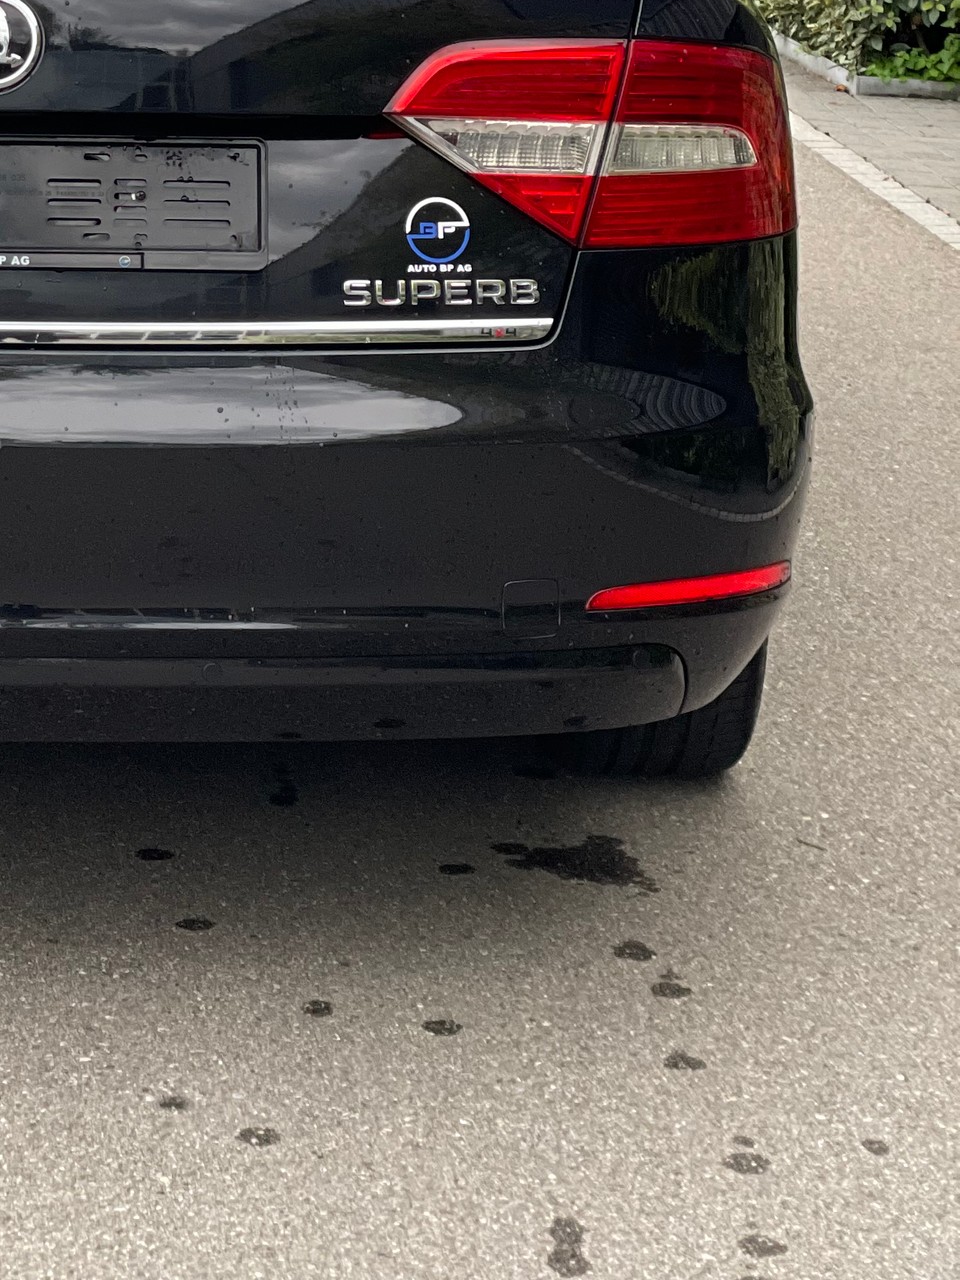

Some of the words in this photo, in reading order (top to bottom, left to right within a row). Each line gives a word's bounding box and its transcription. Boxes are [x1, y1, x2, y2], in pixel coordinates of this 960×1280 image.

[419, 221, 456, 239] BP
[11, 256, 30, 265] AG
[407, 264, 437, 273] AUTO
[440, 264, 454, 273] BP
[457, 264, 473, 273] AG
[343, 279, 540, 306] SUPERB
